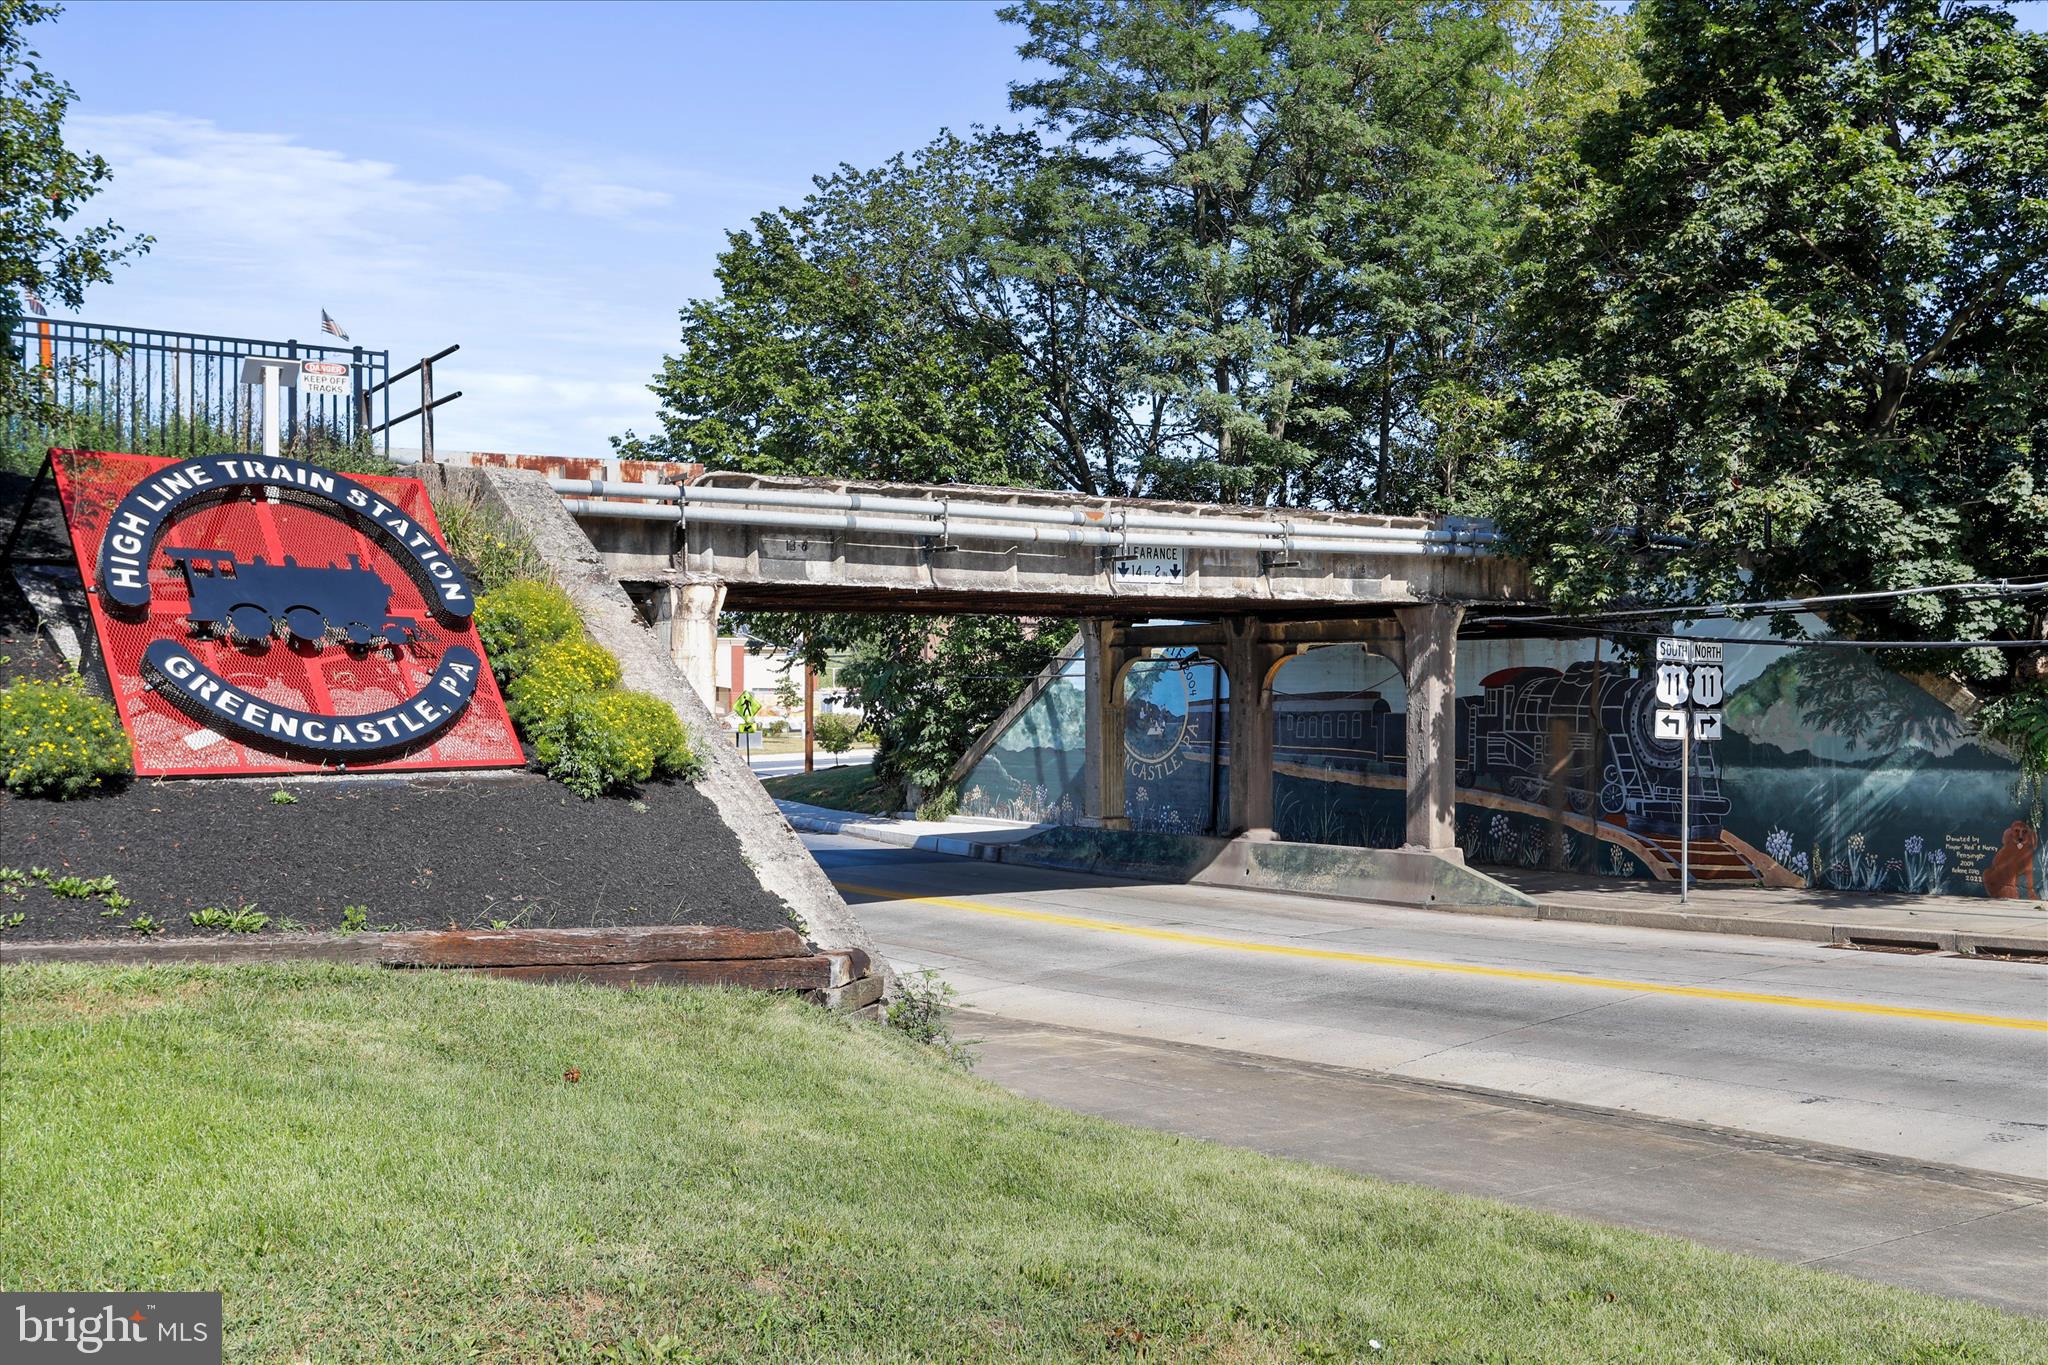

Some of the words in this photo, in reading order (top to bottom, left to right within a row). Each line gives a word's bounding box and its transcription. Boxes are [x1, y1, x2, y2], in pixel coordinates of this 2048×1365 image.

[309, 363, 342, 375] DANGER
[303, 375, 328, 384] KEEP
[330, 377, 347, 385] OFF
[308, 384, 343, 393] TRACKS
[110, 511, 150, 588] HIGH
[137, 465, 213, 512] LINE
[217, 460, 335, 493] TRAIN
[346, 488, 466, 600] STATION
[1132, 564, 1142, 576] 14
[1155, 565, 1161, 577] 2
[1660, 641, 1688, 658] SOUTH
[1694, 643, 1721, 659] NORTH
[1666, 672, 1680, 697] 11
[1701, 674, 1714, 698] 11
[164, 656, 453, 744] GREENCASTLE,
[439, 661, 475, 698] PA
[1124, 748, 1183, 781] NCASTLE,
[1972, 836, 1980, 844] by
